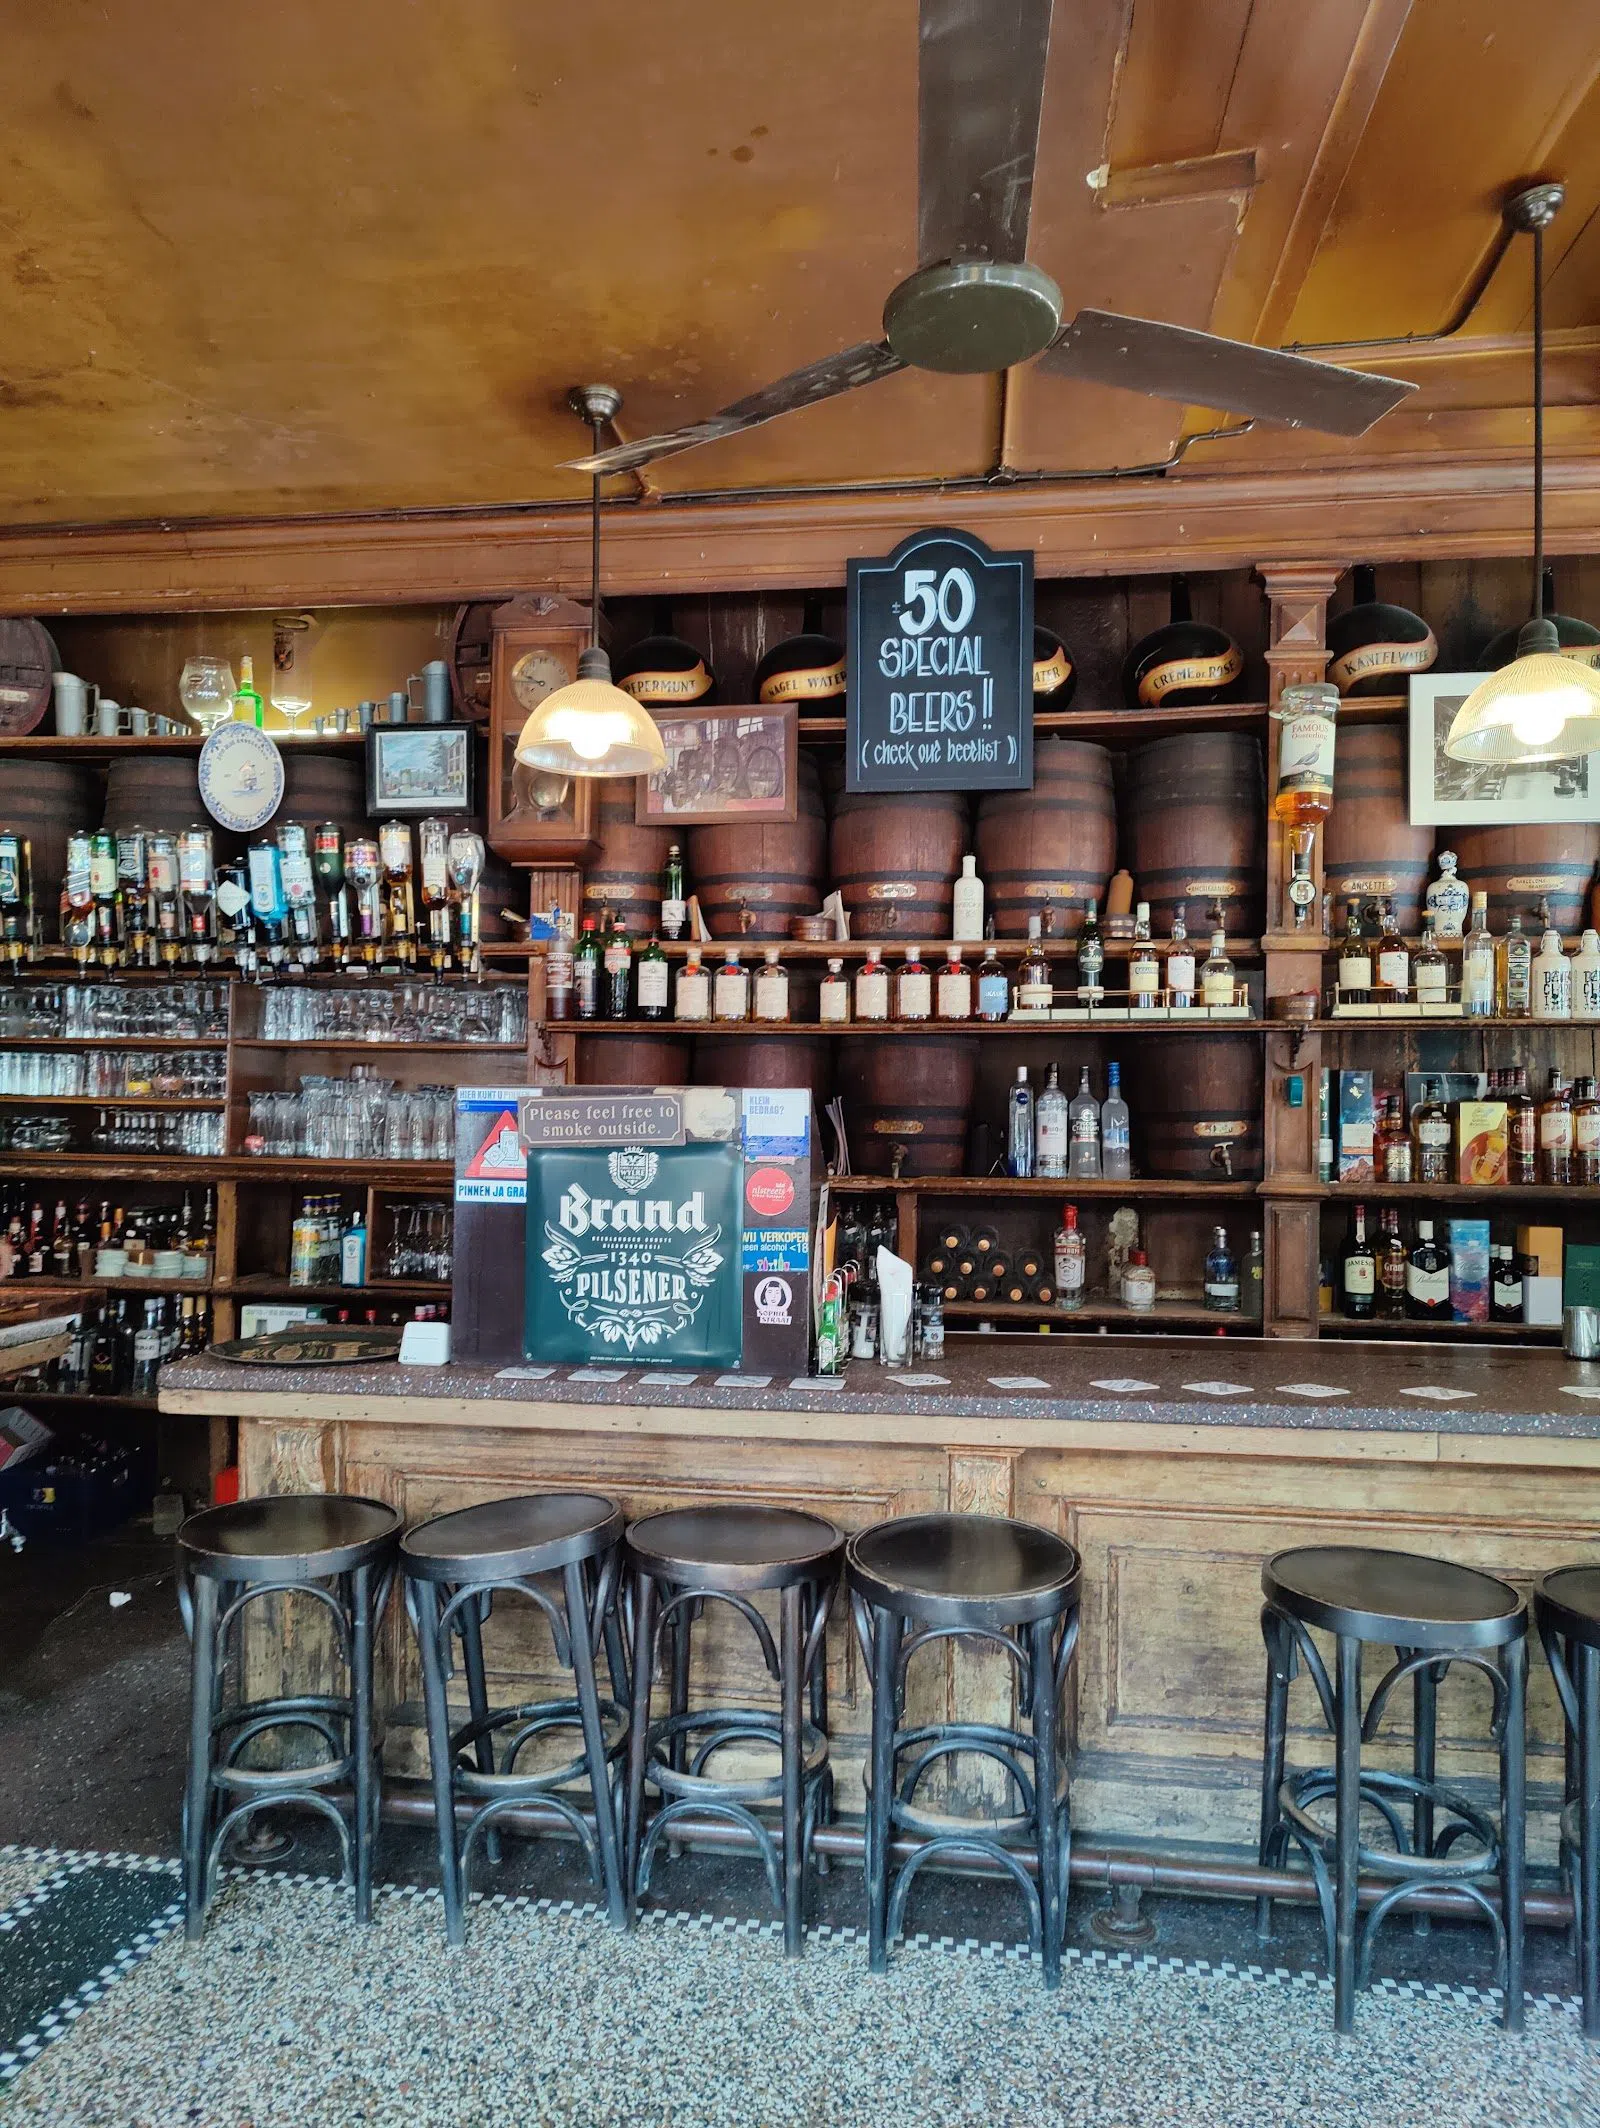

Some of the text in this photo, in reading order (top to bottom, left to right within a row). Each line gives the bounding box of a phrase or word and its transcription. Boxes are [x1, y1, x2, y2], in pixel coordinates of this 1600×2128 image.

[878, 635, 990, 678] SPECIAL
[624, 679, 696, 695] PEPERMUNT
[1153, 668, 1195, 690] CREME
[768, 679, 798, 697] NAGEL
[1291, 723, 1329, 734] FAMOUS
[529, 1104, 675, 1121] Please feel free to
[542, 1121, 662, 1137] smoke outside.
[458, 1185, 491, 1197] PINNEN
[492, 1186, 505, 1197] JA
[559, 1182, 710, 1238] Brand
[760, 1231, 809, 1243] VERKOPEN
[760, 1243, 788, 1251] alcohol
[789, 1242, 809, 1254] <18
[610, 1251, 652, 1267] 1340
[575, 1268, 689, 1305] PILSENER
